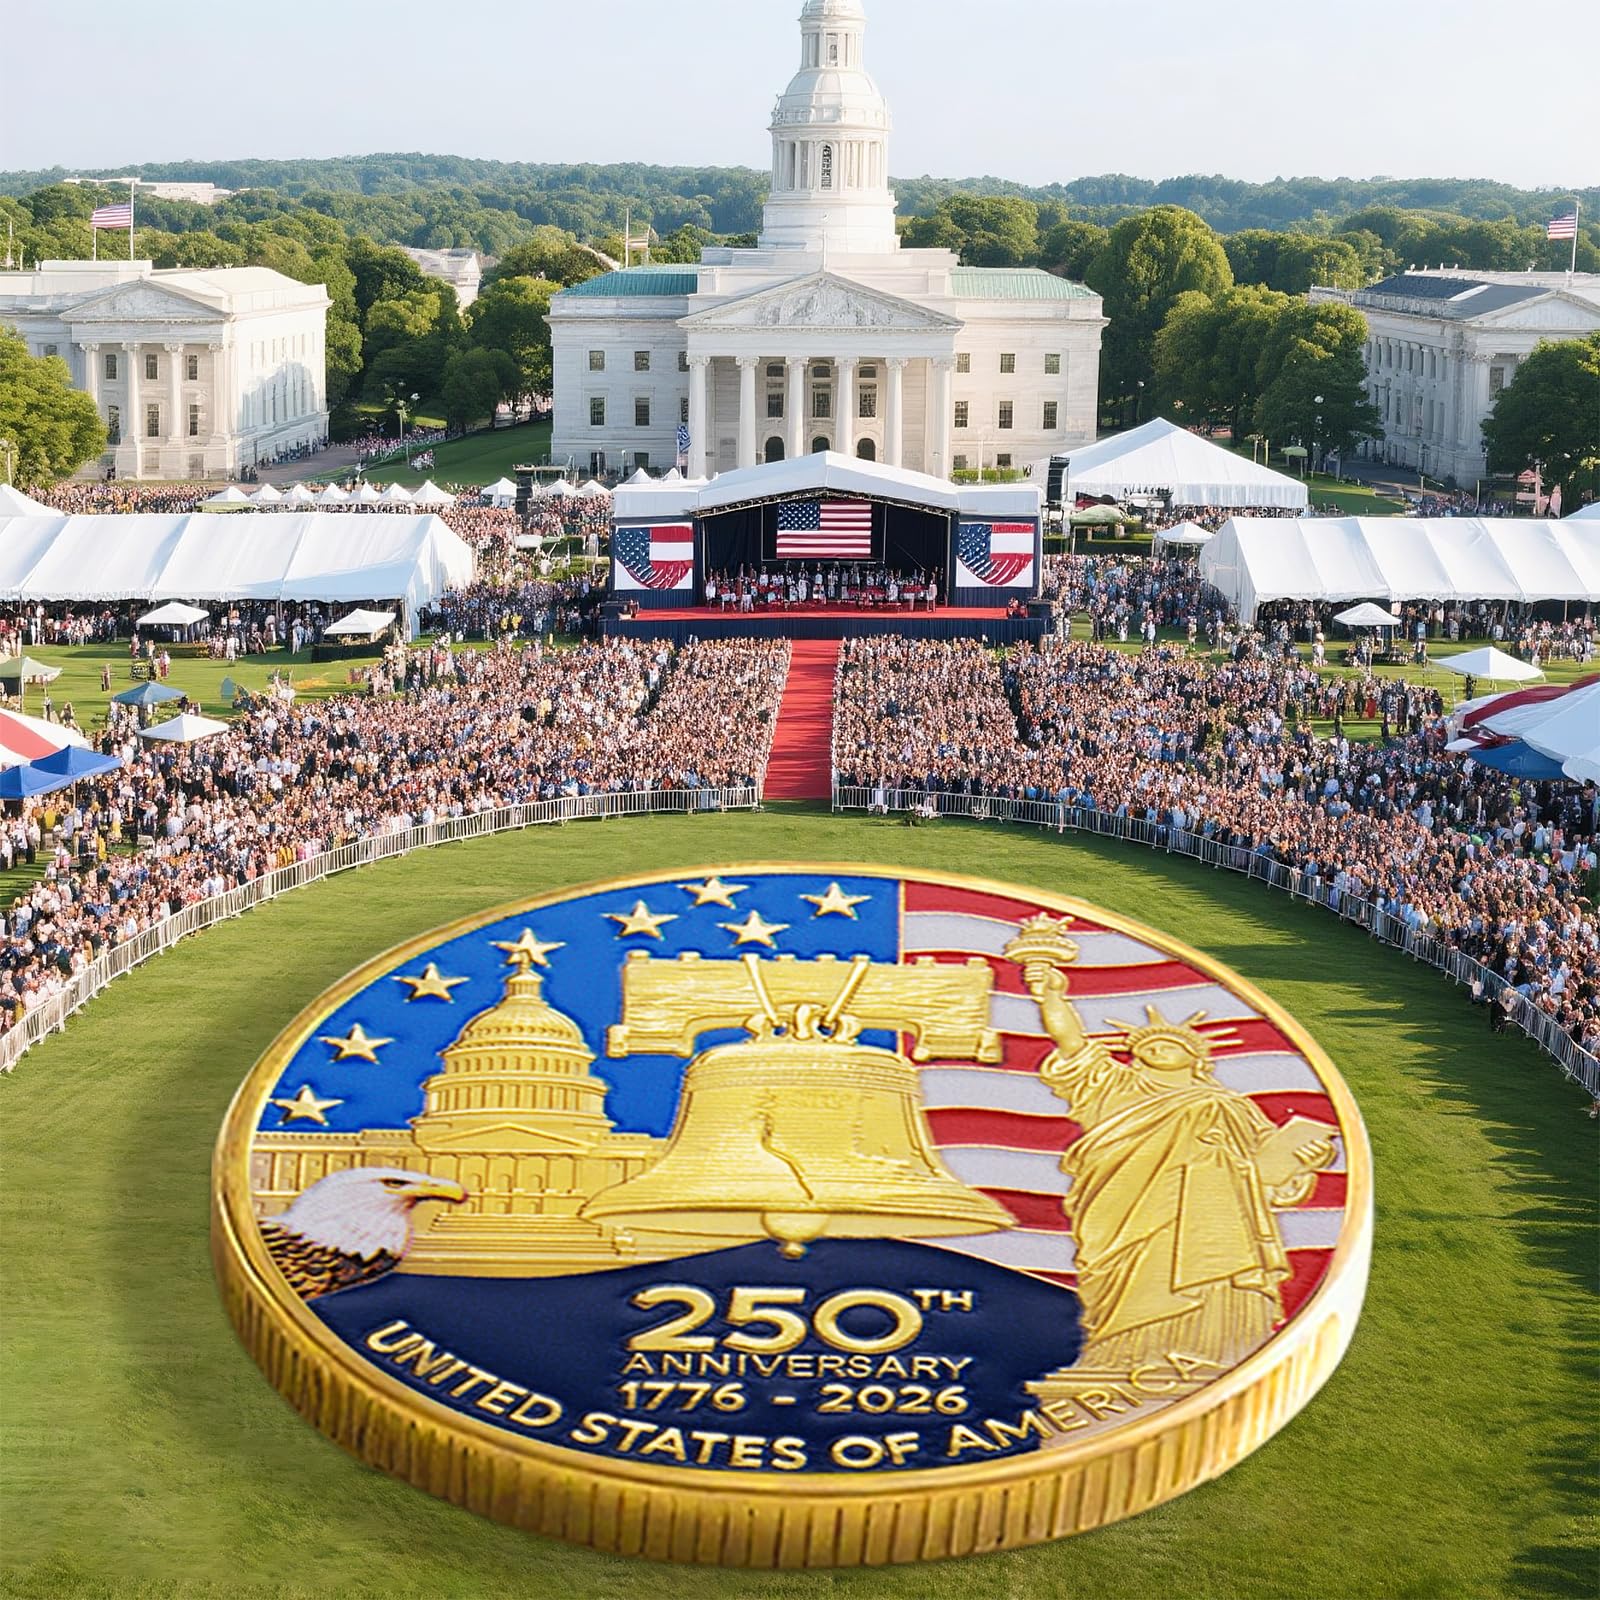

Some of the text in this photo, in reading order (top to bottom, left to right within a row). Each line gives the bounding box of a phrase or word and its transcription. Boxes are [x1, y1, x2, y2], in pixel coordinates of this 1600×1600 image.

[622, 1353, 973, 1379] ANNIVERSARY
[366, 1320, 1222, 1470] UNITED STATES OF AMERICA
[619, 1382, 745, 1412] 1776
[817, 1384, 969, 1415] 2026
